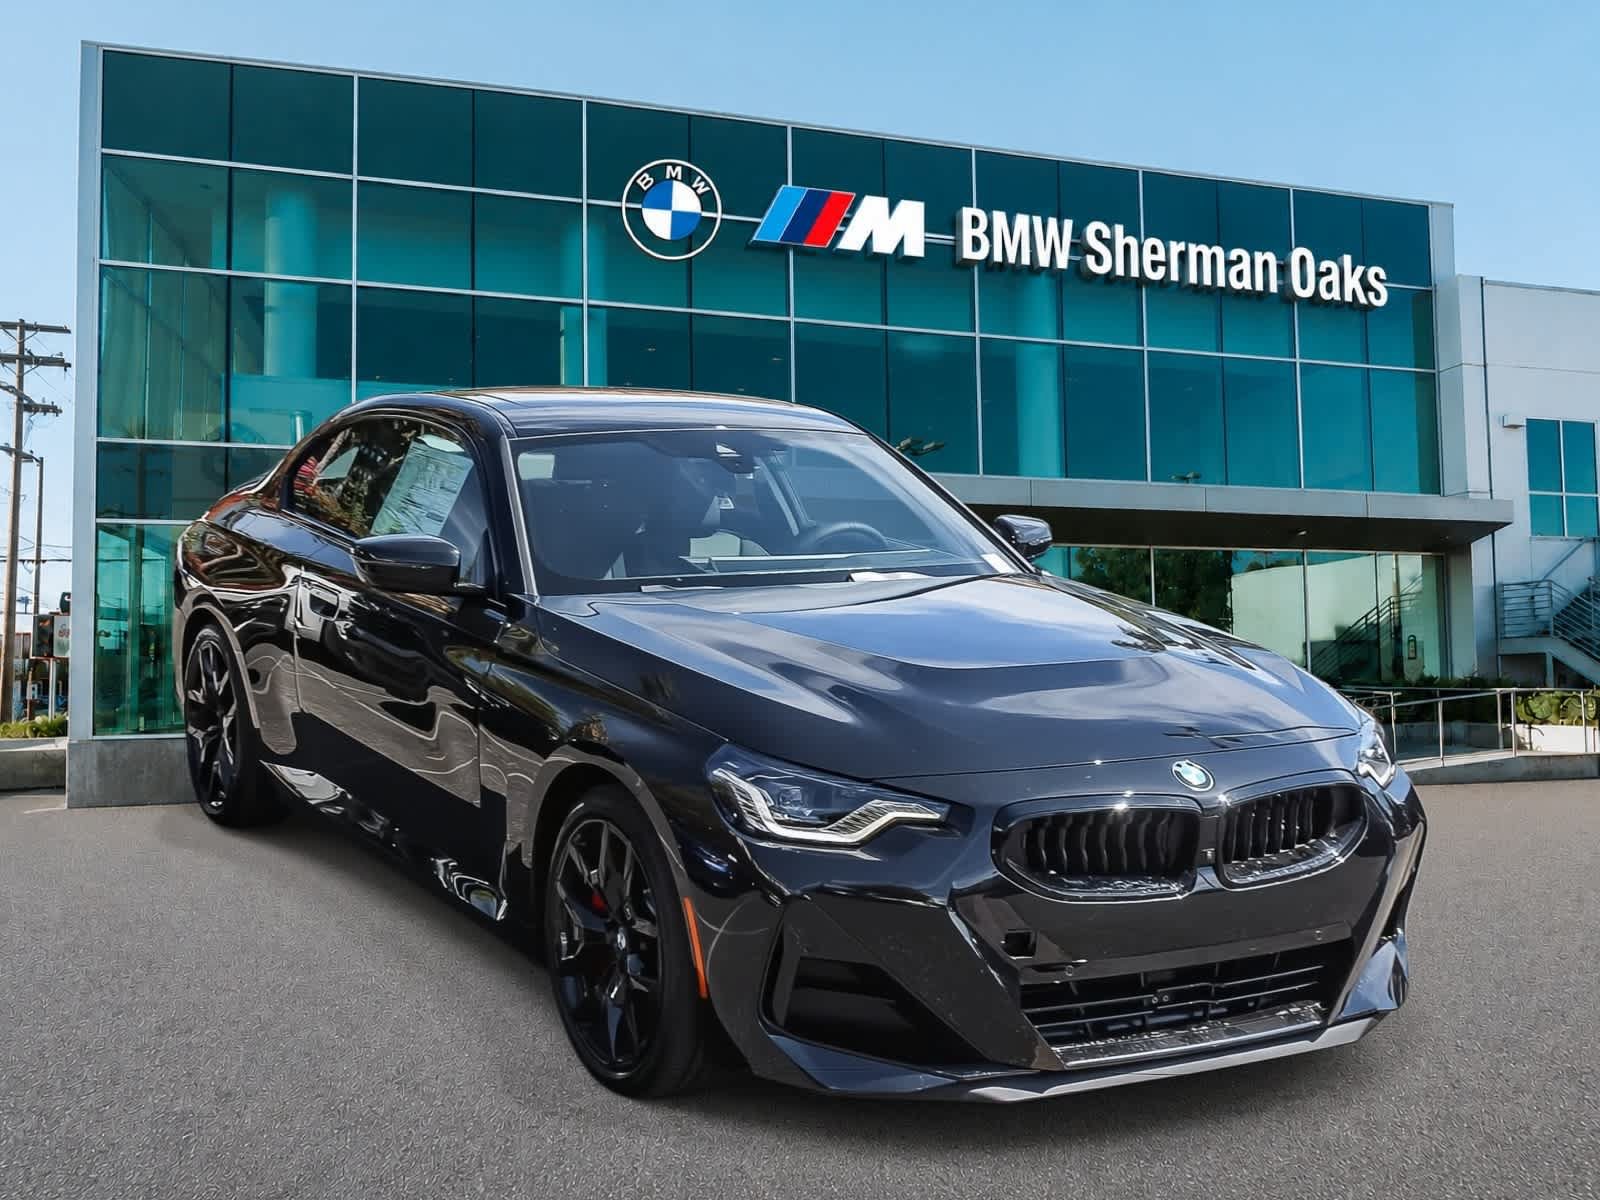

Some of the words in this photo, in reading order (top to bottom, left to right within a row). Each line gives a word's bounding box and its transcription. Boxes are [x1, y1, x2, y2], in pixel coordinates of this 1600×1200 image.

[636, 165, 711, 195] BMW
[836, 195, 925, 258] M
[961, 206, 1073, 269] BMW
[1085, 220, 1278, 294] Sherman
[1290, 247, 1388, 307] Oaks
